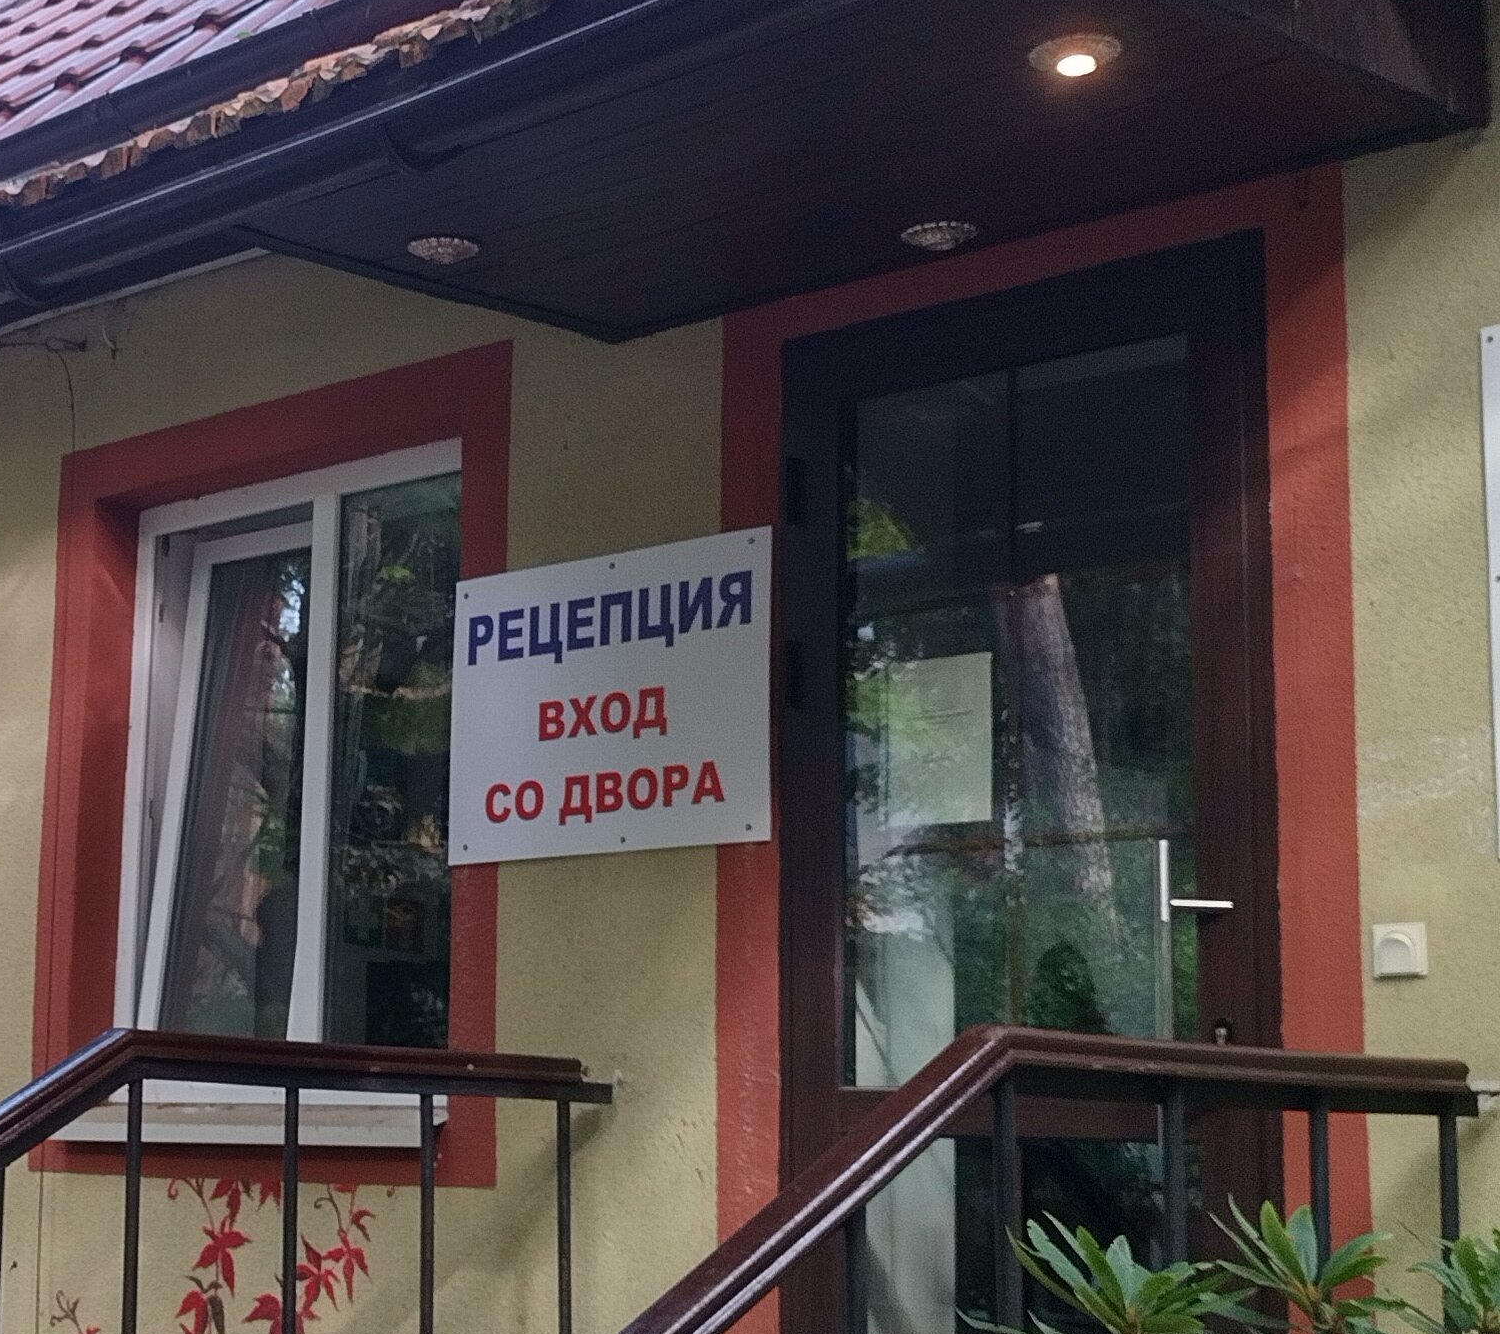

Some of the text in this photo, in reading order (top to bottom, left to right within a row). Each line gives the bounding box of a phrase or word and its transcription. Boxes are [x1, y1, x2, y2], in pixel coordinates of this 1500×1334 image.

[466, 569, 753, 666] РЕЦЕПЦИЯ
[537, 685, 668, 742] ВХОД
[484, 759, 726, 826] СО ДВОРА
